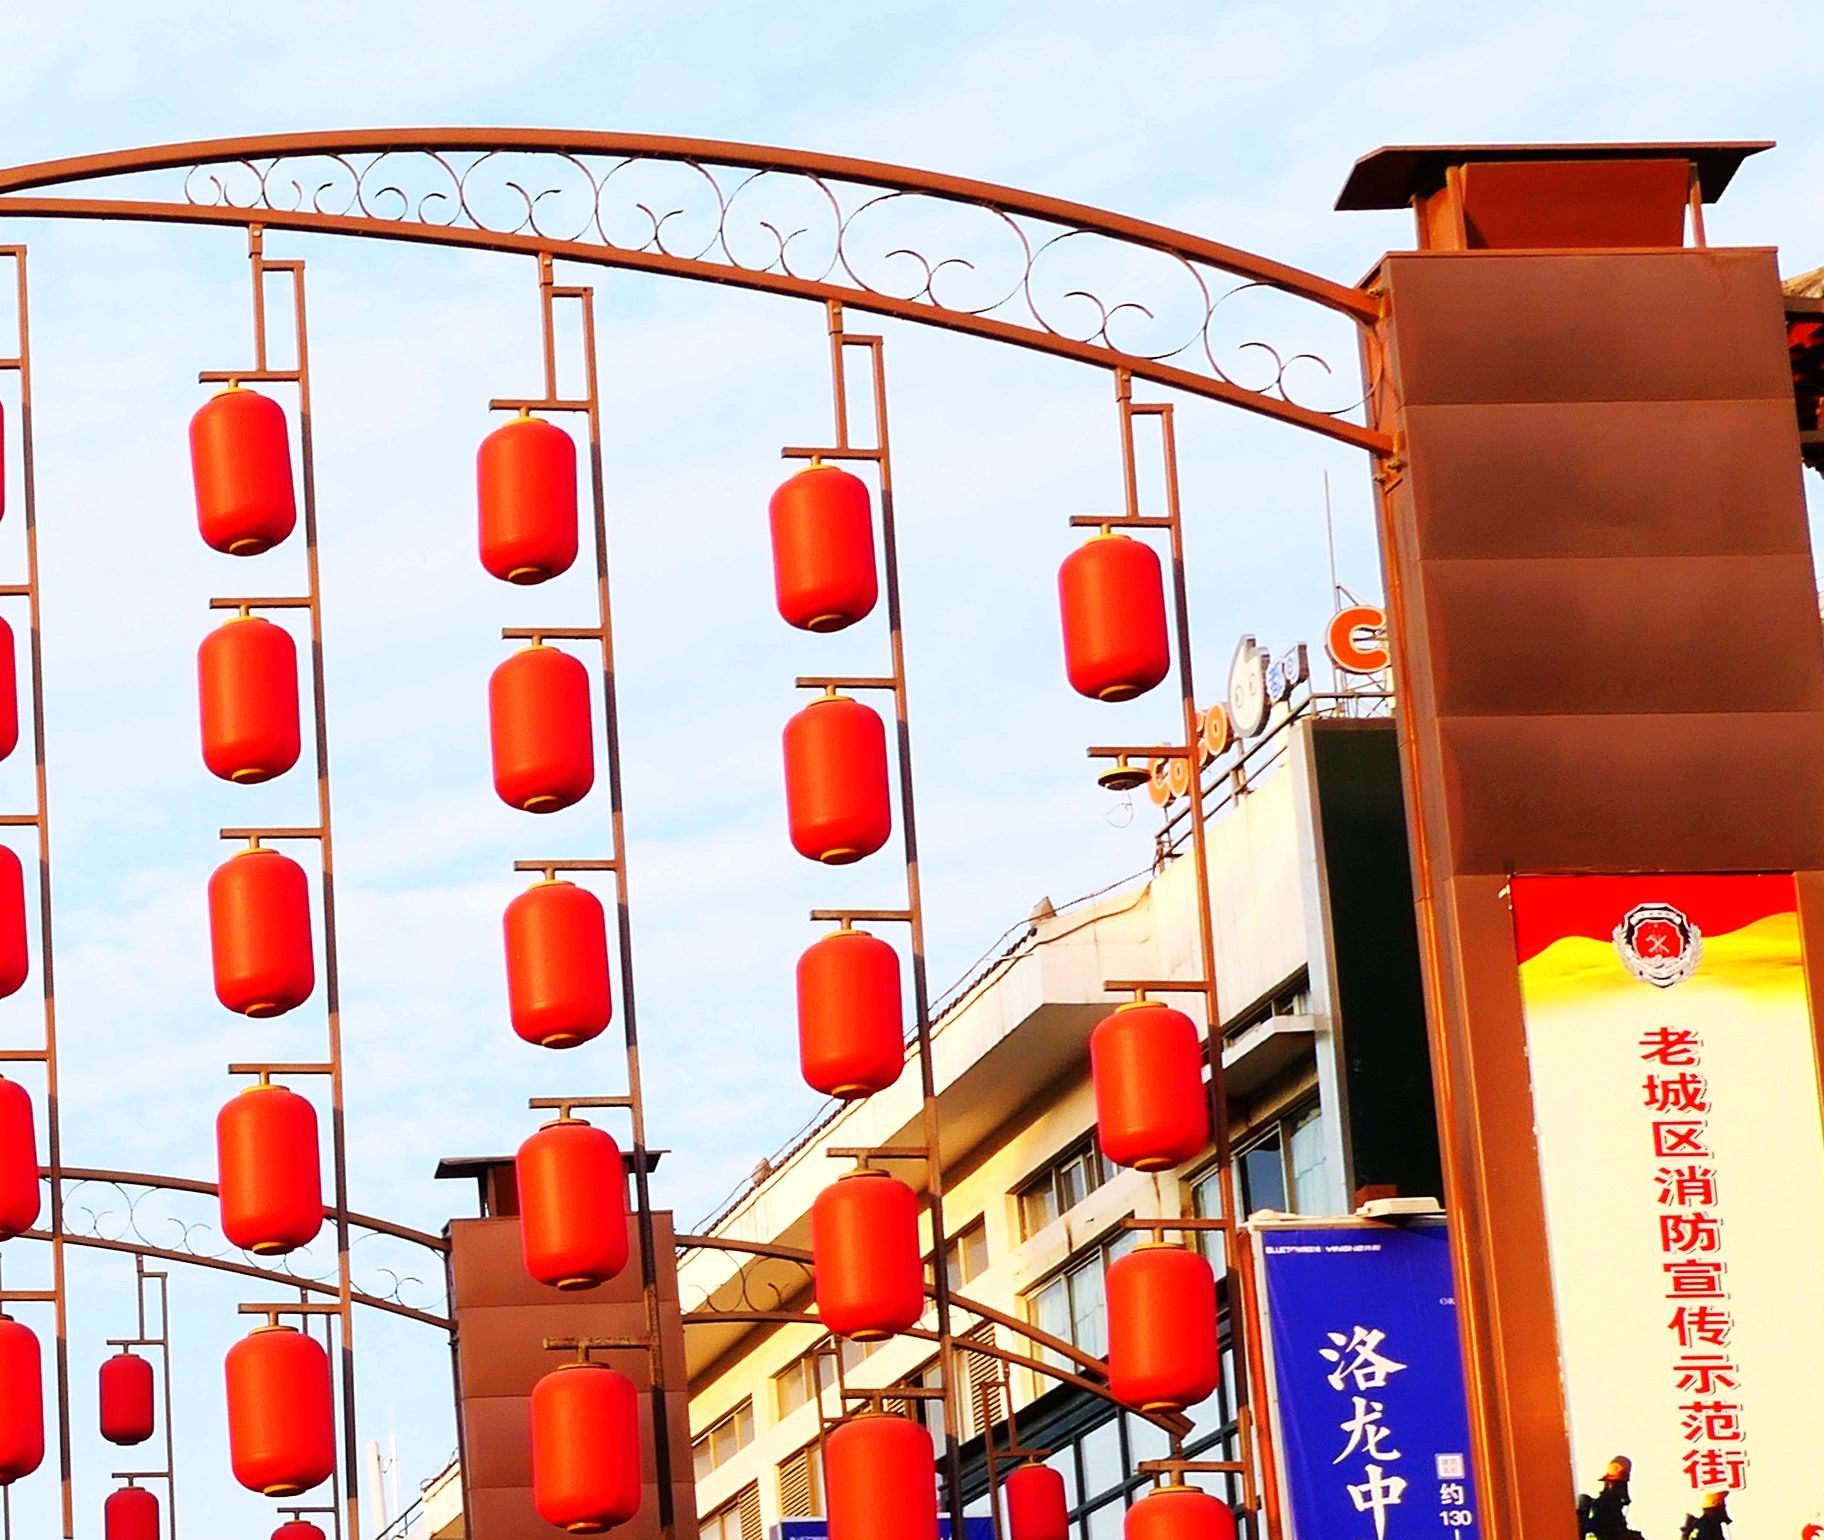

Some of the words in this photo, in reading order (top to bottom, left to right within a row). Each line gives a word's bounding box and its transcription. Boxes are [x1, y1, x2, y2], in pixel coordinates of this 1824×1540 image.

[1639, 1026, 1748, 1490] 老城区消防宣传示范街
